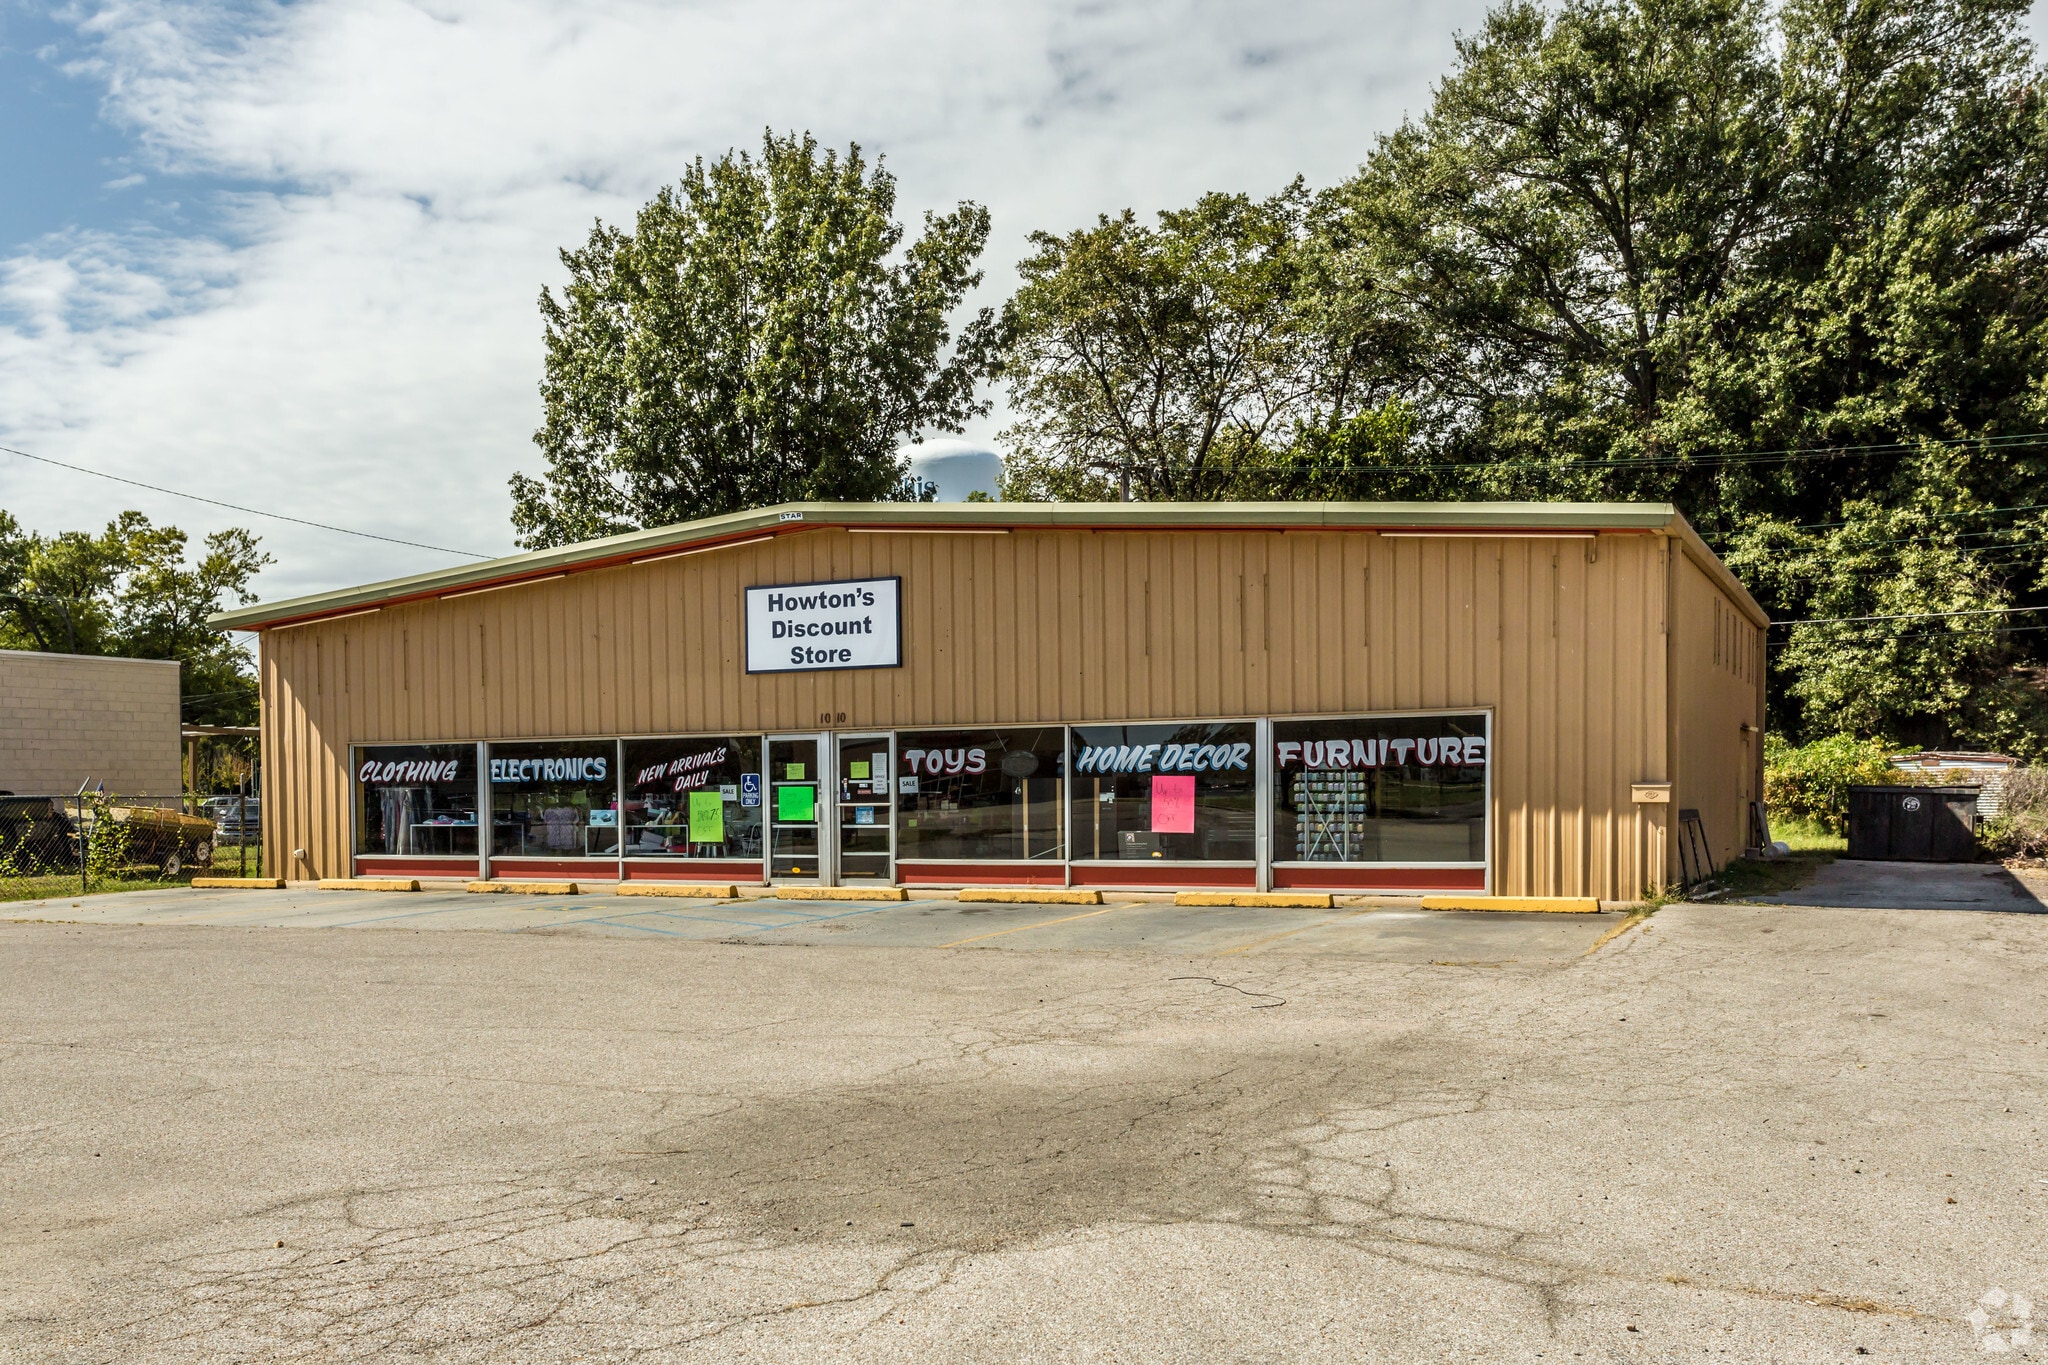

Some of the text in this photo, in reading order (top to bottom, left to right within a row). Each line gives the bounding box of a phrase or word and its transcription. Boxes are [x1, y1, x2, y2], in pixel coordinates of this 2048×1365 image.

[780, 512, 802, 520] STAR
[768, 587, 875, 612] Howton's
[772, 616, 872, 639] Discount
[790, 646, 852, 665] Store
[904, 748, 987, 775] TOYS
[1076, 742, 1252, 773] HOME DECOR
[1276, 737, 1486, 769] FURNITURE
[359, 760, 459, 783] CLOTHING
[490, 757, 607, 783] ELECTRONICS
[637, 762, 668, 784] NEW
[674, 770, 709, 792] DAILY
